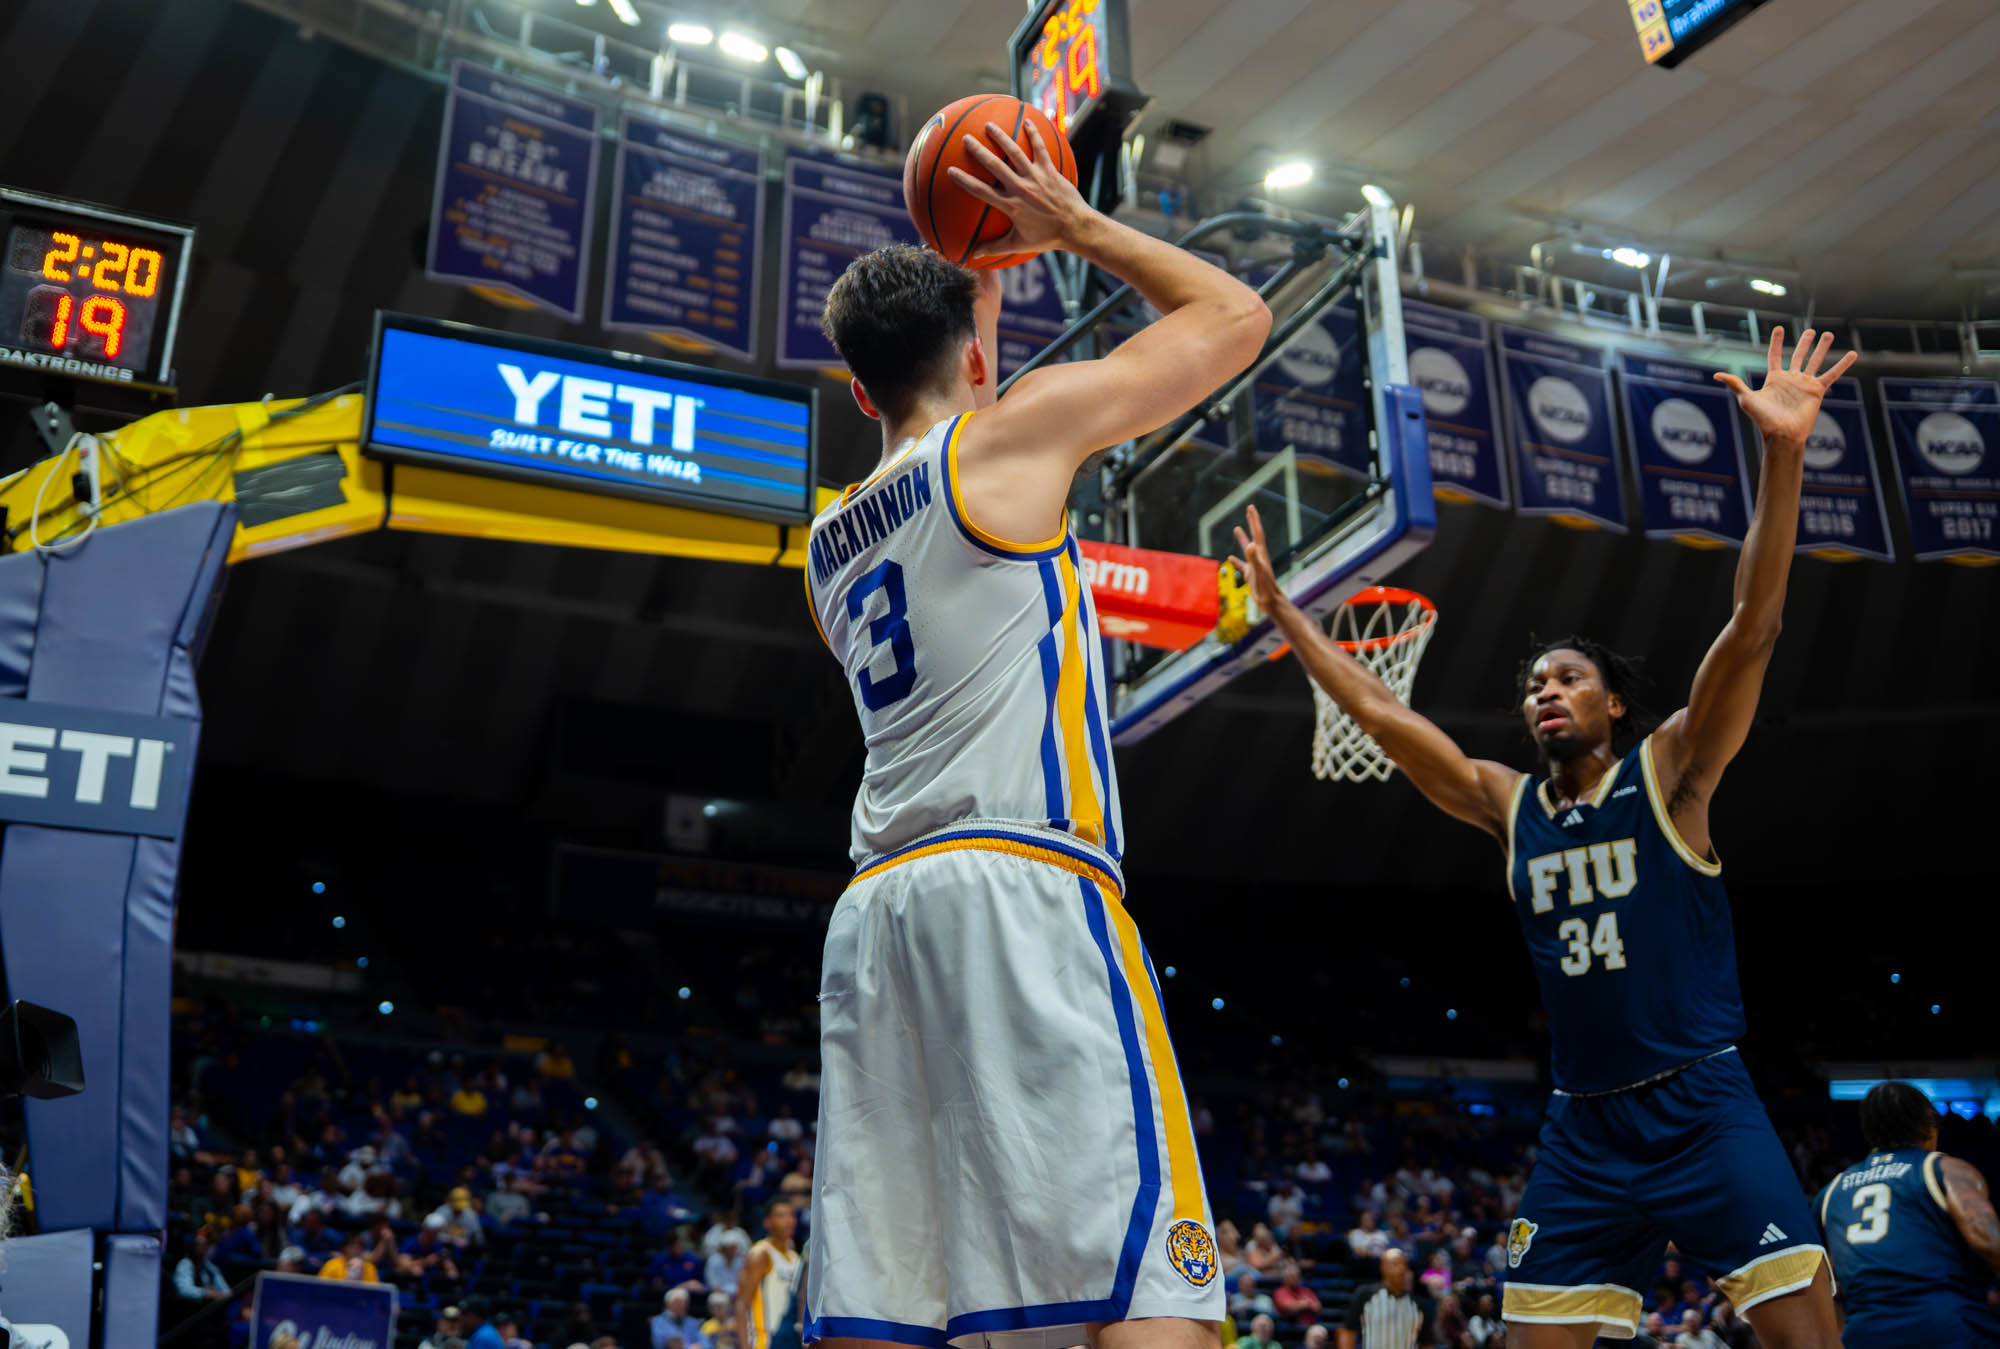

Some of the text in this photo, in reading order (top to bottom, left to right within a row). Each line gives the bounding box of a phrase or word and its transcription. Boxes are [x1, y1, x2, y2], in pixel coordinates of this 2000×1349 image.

[1043, 0, 1100, 69] 2:2
[1054, 23, 1100, 137] 19
[42, 231, 163, 298] 2:20
[51, 294, 127, 359] 19
[497, 363, 697, 453] YETI
[489, 428, 554, 455] BUILT
[556, 439, 602, 464] FOR
[604, 447, 644, 472] THE
[810, 461, 932, 585] MACKINNON
[1082, 557, 1149, 595] arm
[846, 558, 918, 713] 3
[0, 722, 166, 811] ETI
[1527, 837, 1639, 915] FIU
[1558, 911, 1627, 977] 34
[1846, 1182, 1892, 1245] 3
